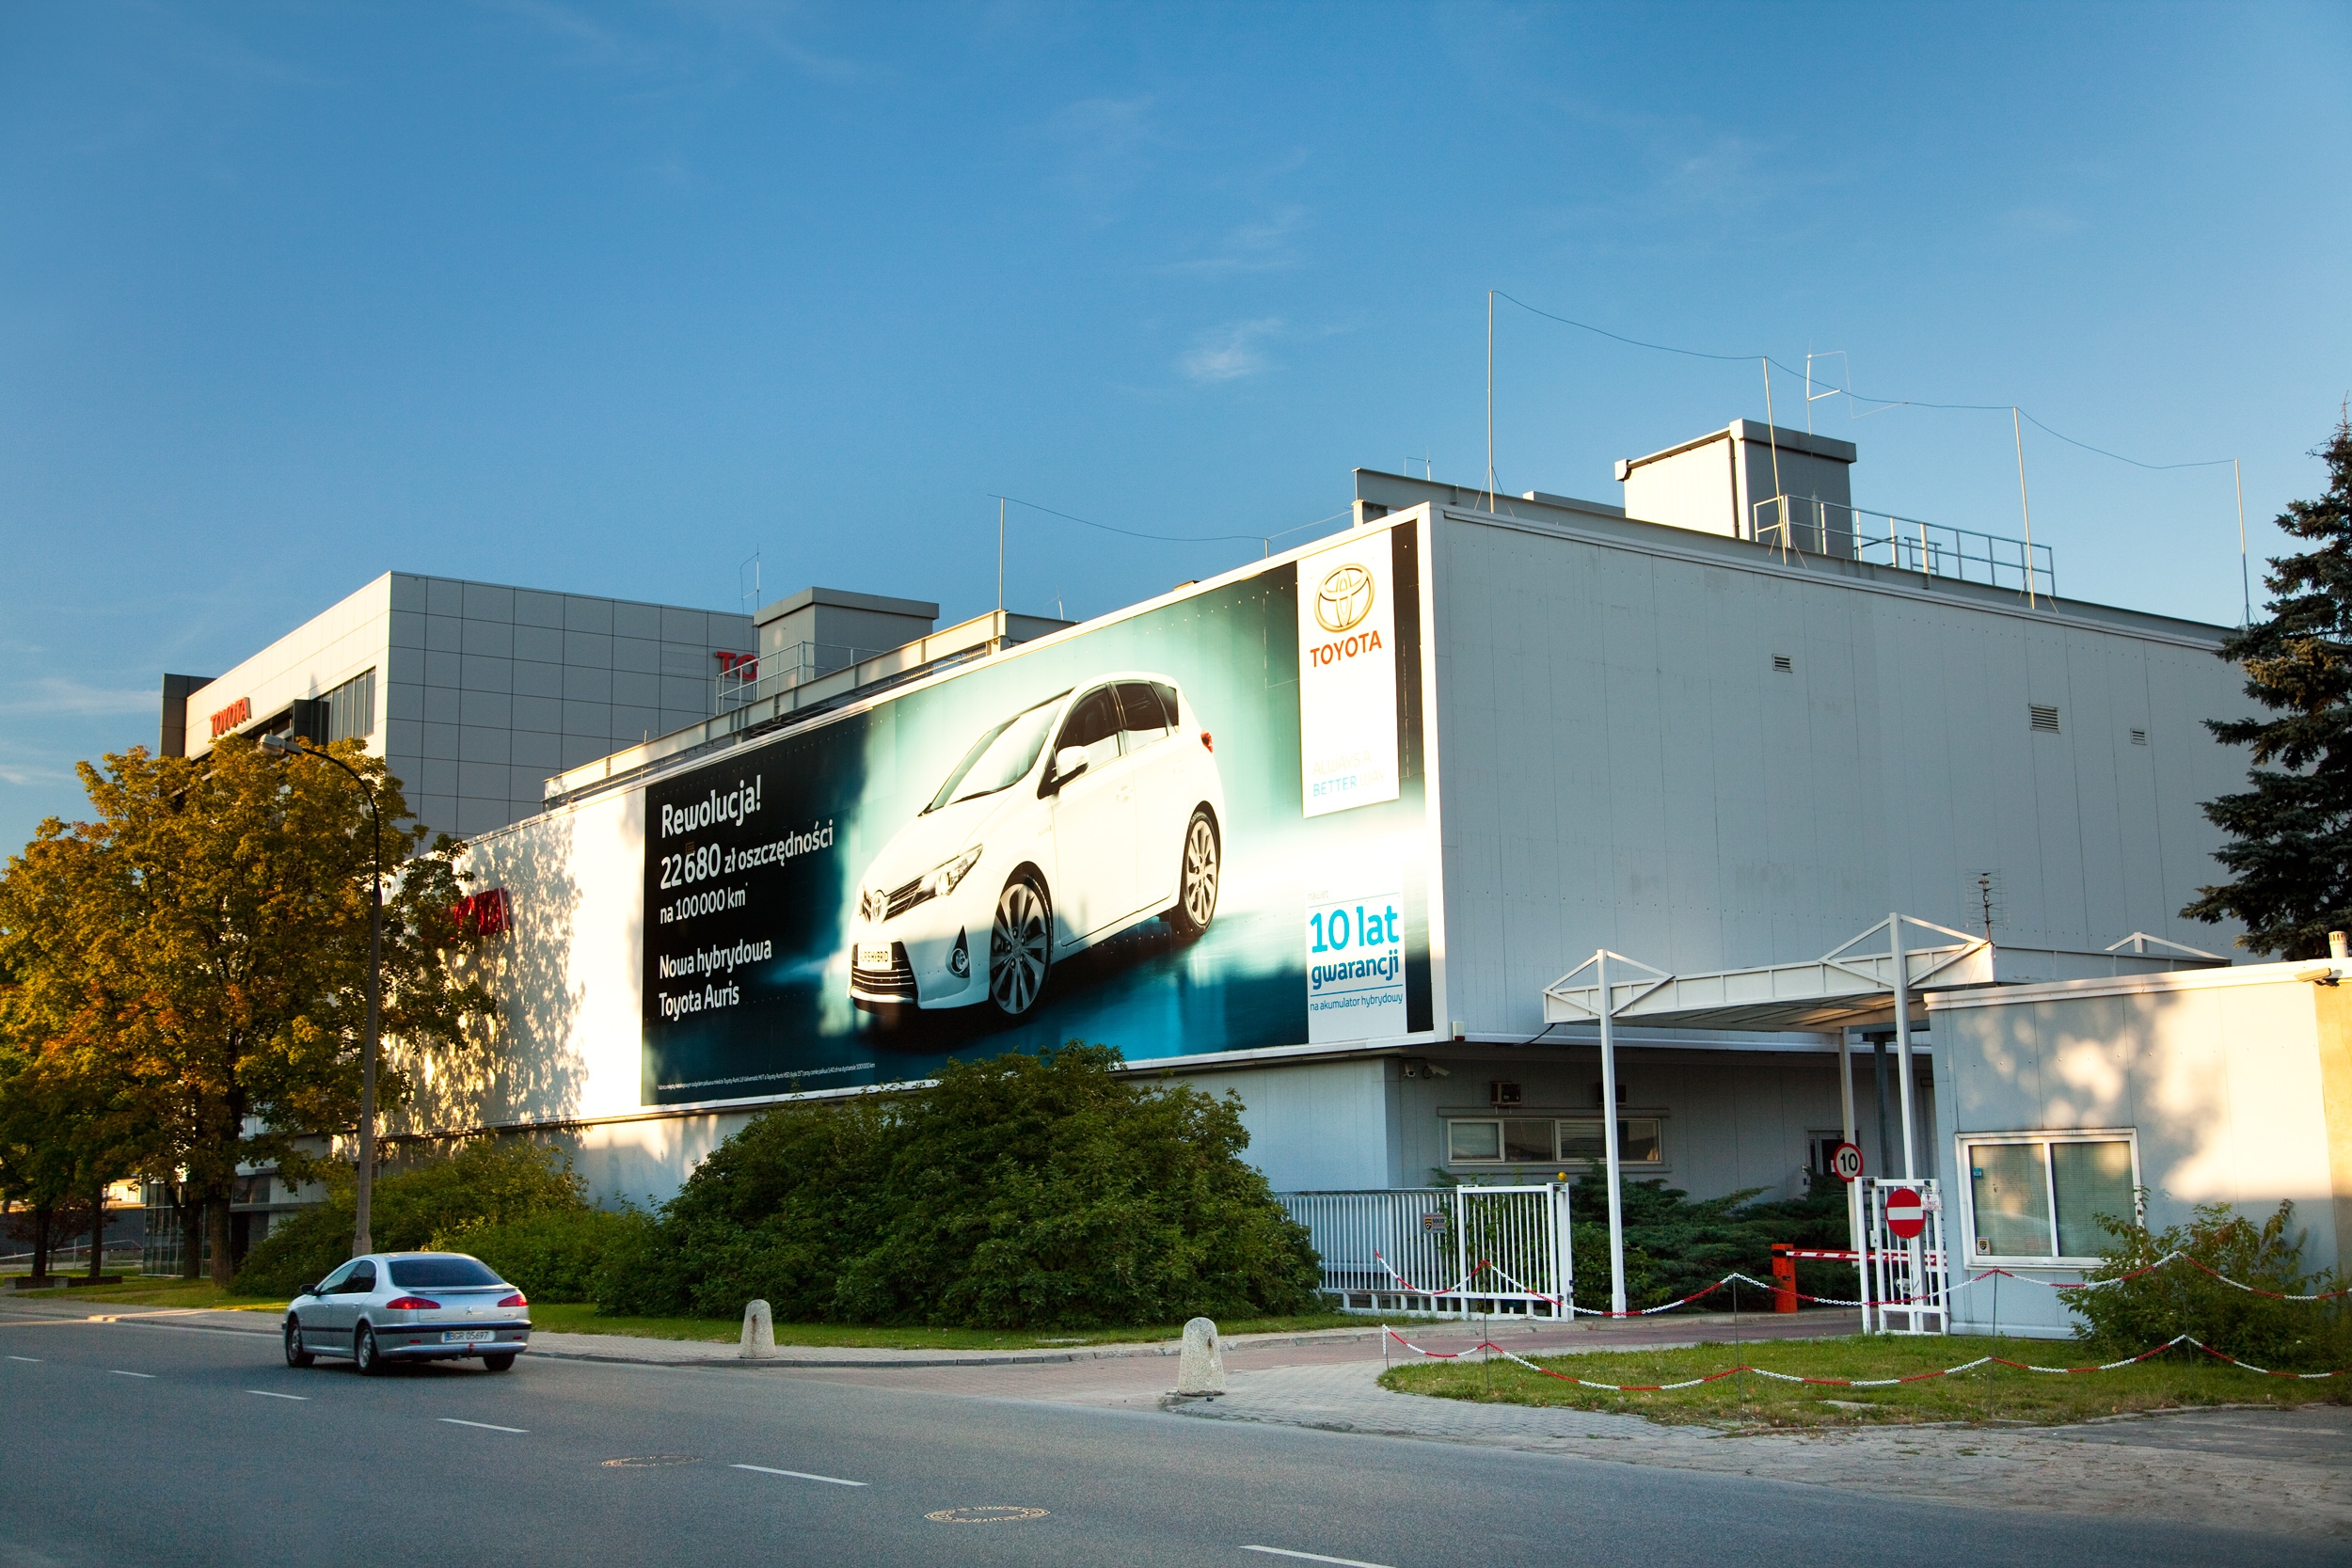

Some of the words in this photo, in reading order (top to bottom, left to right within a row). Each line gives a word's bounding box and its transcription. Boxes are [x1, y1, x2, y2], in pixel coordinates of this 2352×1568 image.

[1310, 630, 1382, 668] TOYOTA
[210, 697, 251, 738] TOYOTA
[1312, 752, 1361, 776] ALWAYS
[1362, 750, 1373, 765] A
[1313, 775, 1358, 798] BETTER
[1359, 768, 1386, 787] WAY
[660, 774, 762, 839] Rewolucja!
[724, 847, 737, 874] zł
[738, 818, 834, 871] oszczędności
[660, 906, 674, 925] na
[1310, 909, 1350, 953] 10
[1356, 905, 1400, 947] lat
[660, 954, 694, 979] Nowa
[696, 939, 772, 978] hybrydowa
[1311, 949, 1399, 990] gwarancji
[659, 989, 702, 1022] Toyota
[704, 981, 740, 1011] Auris
[1310, 1002, 1319, 1011] na
[1319, 997, 1360, 1010] akumulator
[1360, 992, 1404, 1007] hybrydowy
[1839, 1153, 1858, 1172] 10
